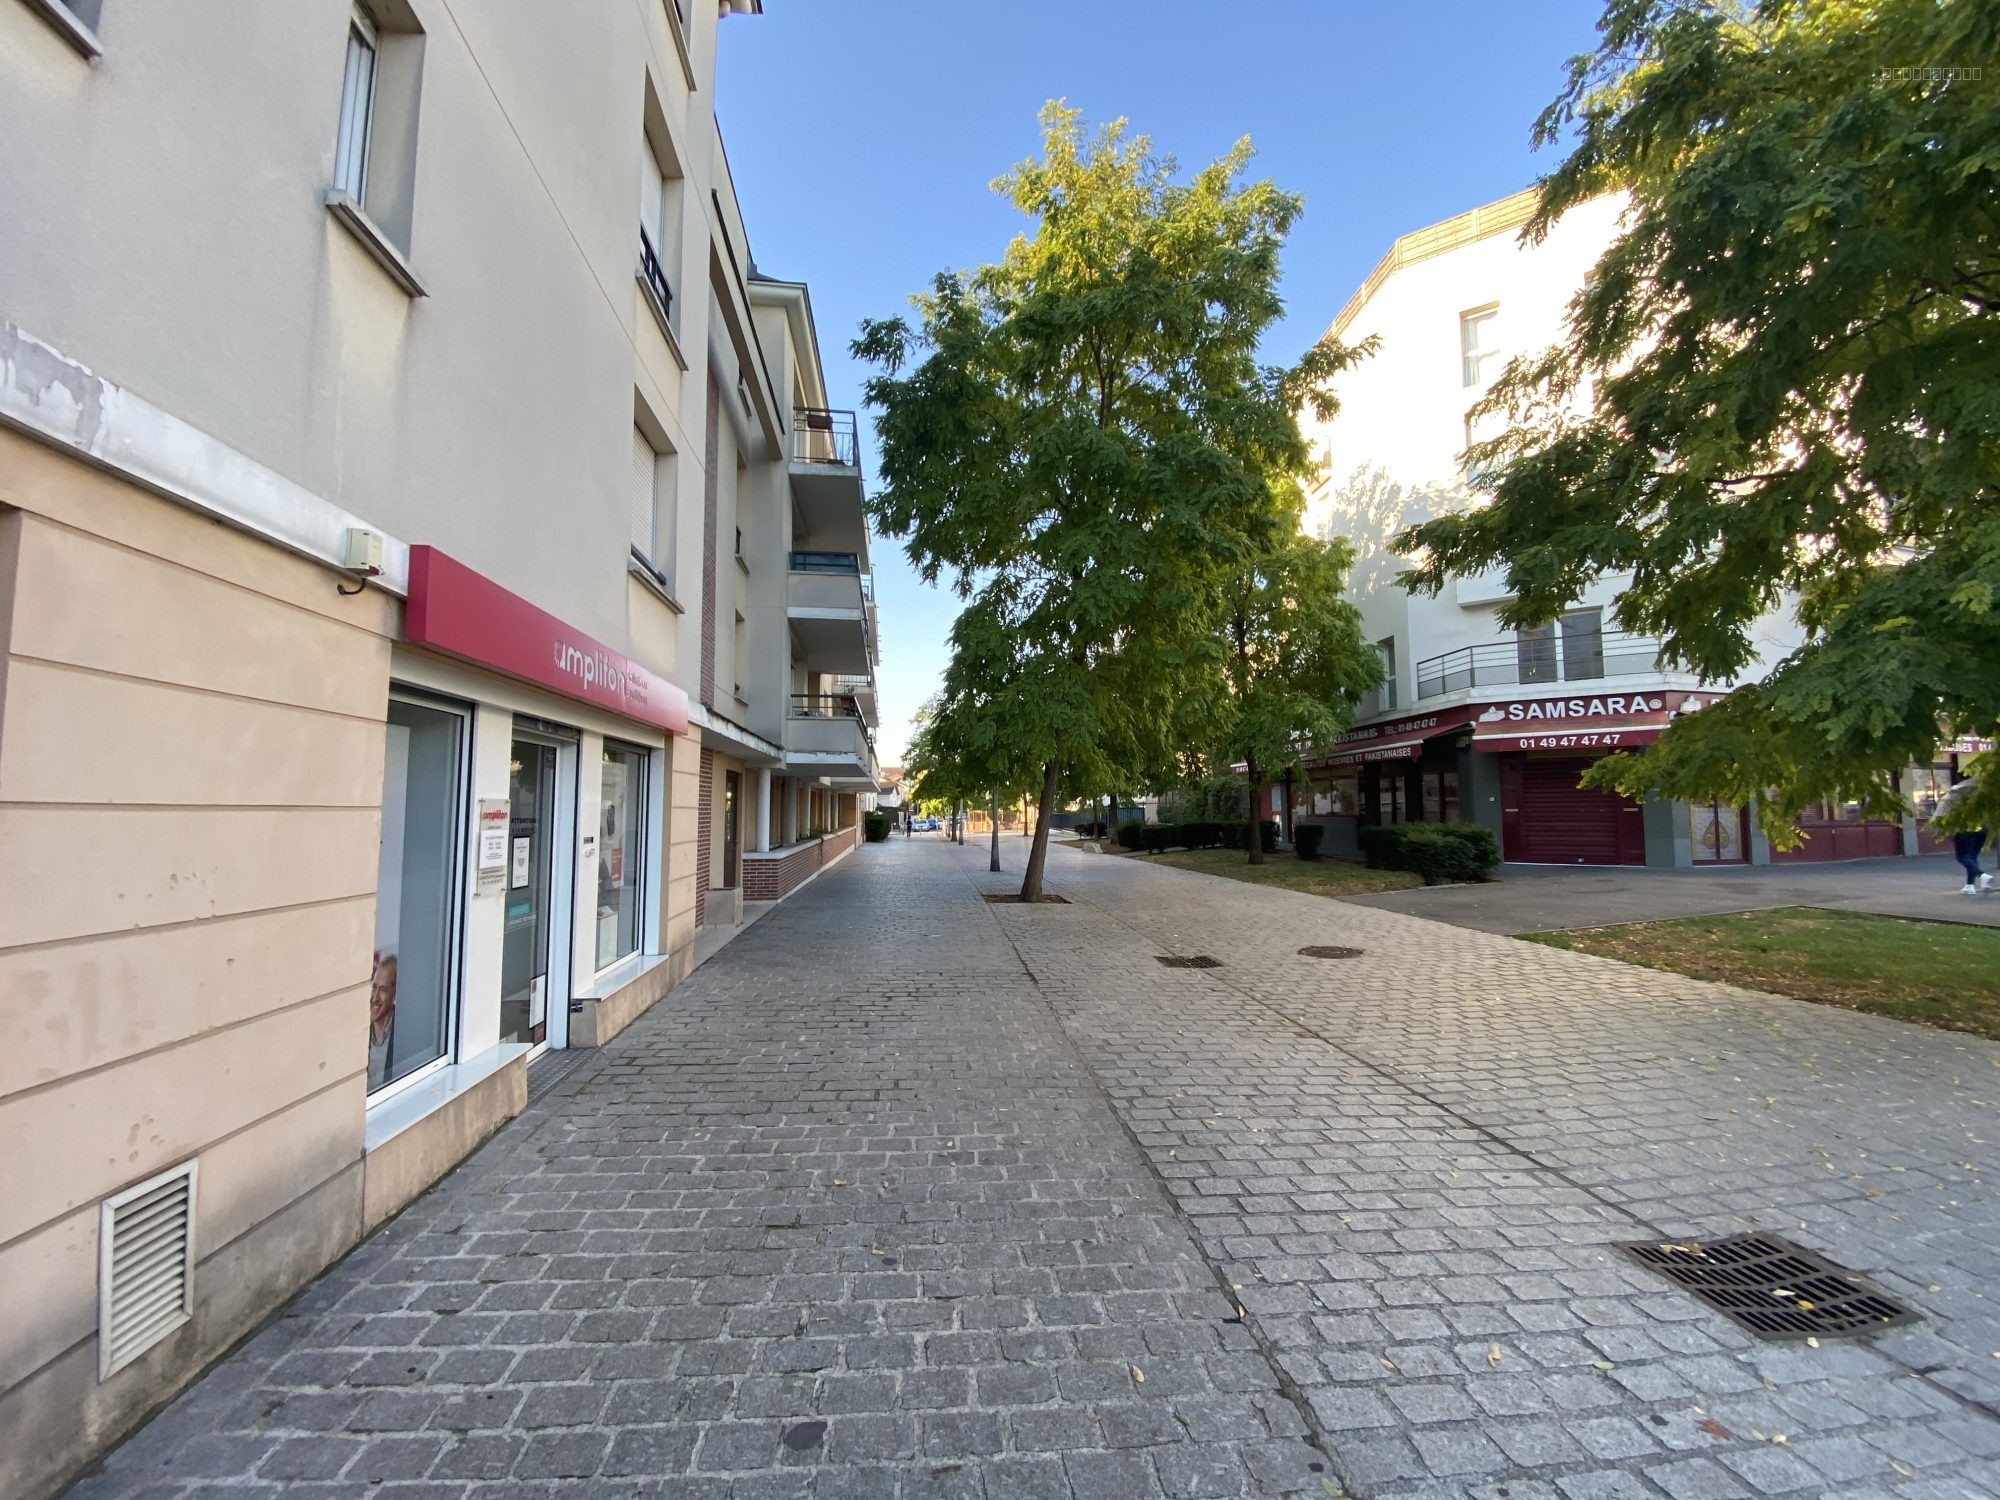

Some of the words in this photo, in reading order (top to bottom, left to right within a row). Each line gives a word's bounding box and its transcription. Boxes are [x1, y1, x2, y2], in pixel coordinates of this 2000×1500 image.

[553, 639, 626, 696] amplifon
[1508, 695, 1650, 721] SAMSARA
[1519, 738, 1535, 749] 01
[1539, 736, 1557, 748] 49
[1560, 736, 1577, 747] 47
[1581, 735, 1598, 746] 47
[1602, 734, 1621, 745] 47
[1364, 747, 1412, 761] PAKISTANAISES
